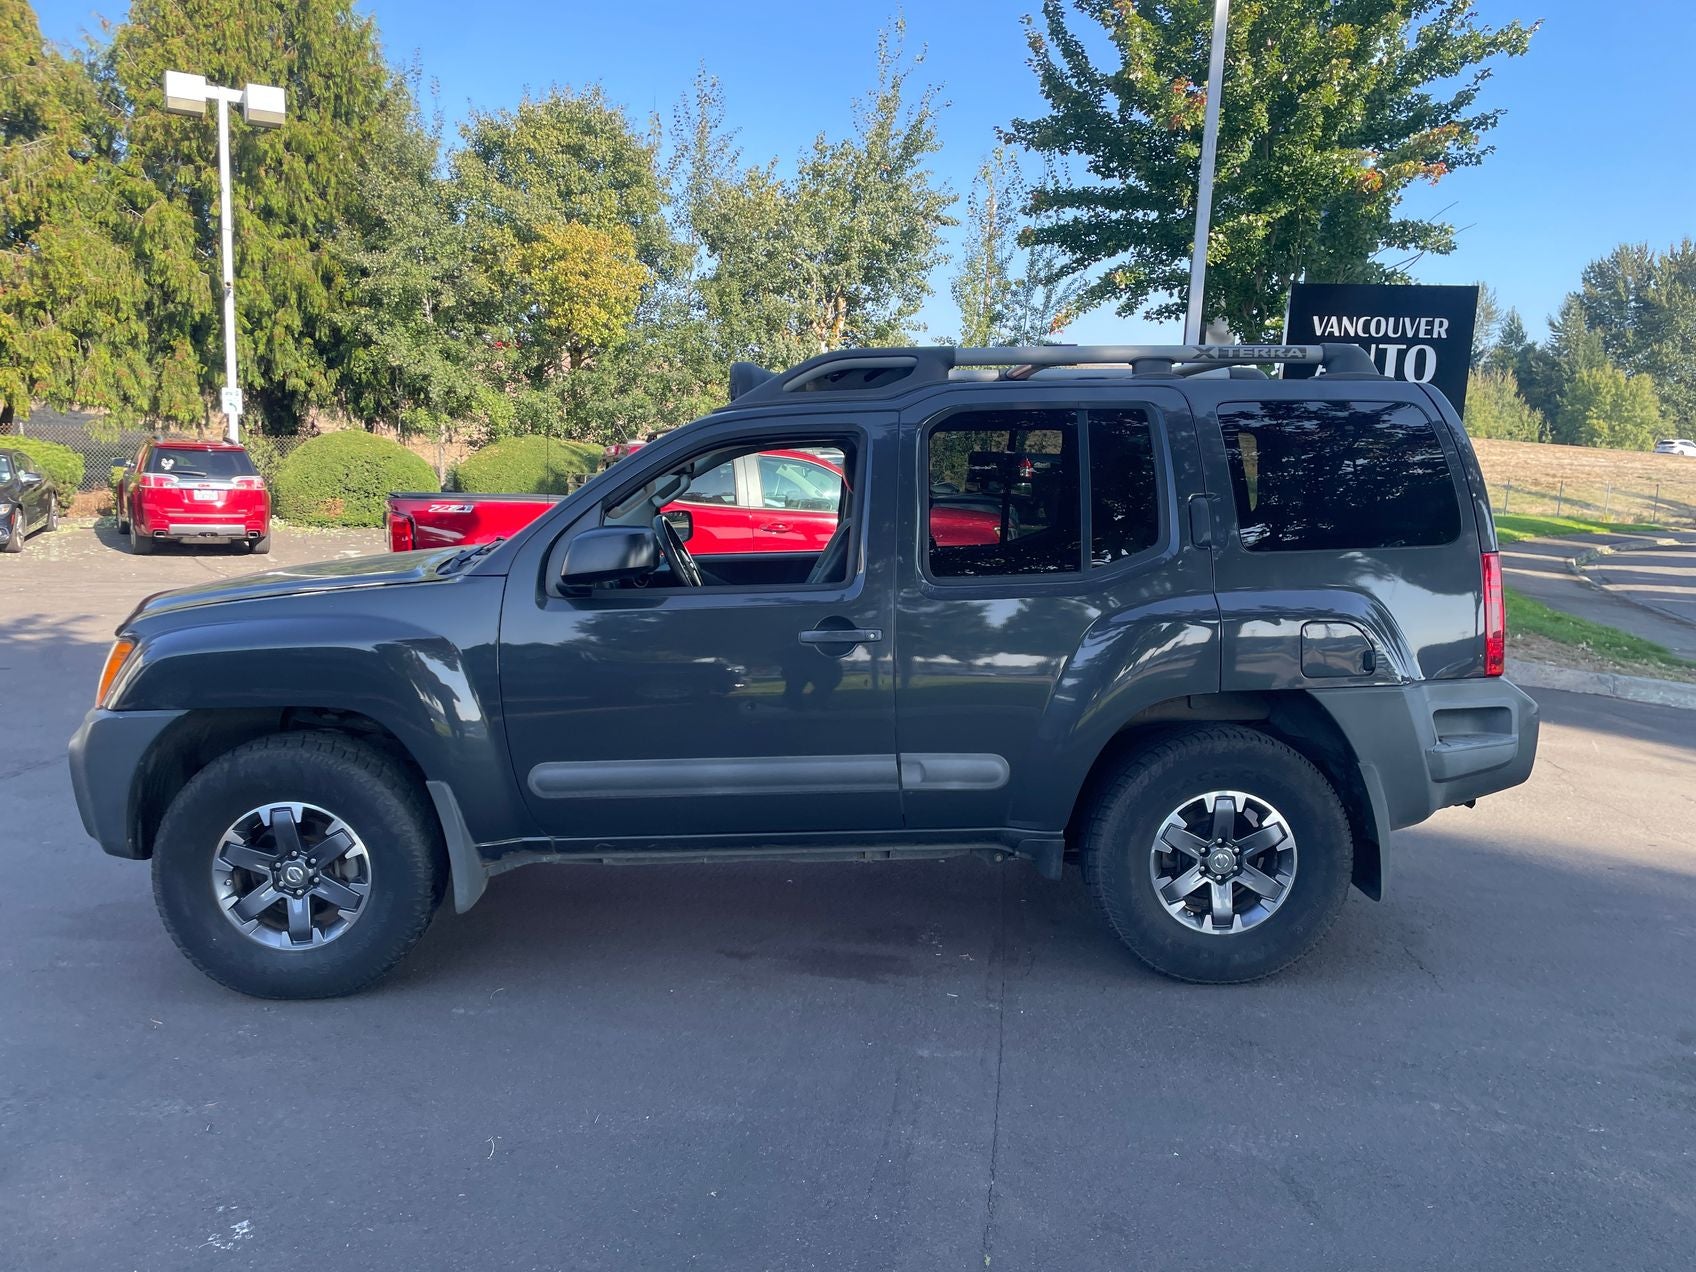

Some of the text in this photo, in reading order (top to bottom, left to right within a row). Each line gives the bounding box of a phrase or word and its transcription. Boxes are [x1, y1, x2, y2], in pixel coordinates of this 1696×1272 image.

[1313, 315, 1449, 338] VANCOUVER
[1192, 346, 1305, 359] XTERRA
[1315, 343, 1437, 383] TO
